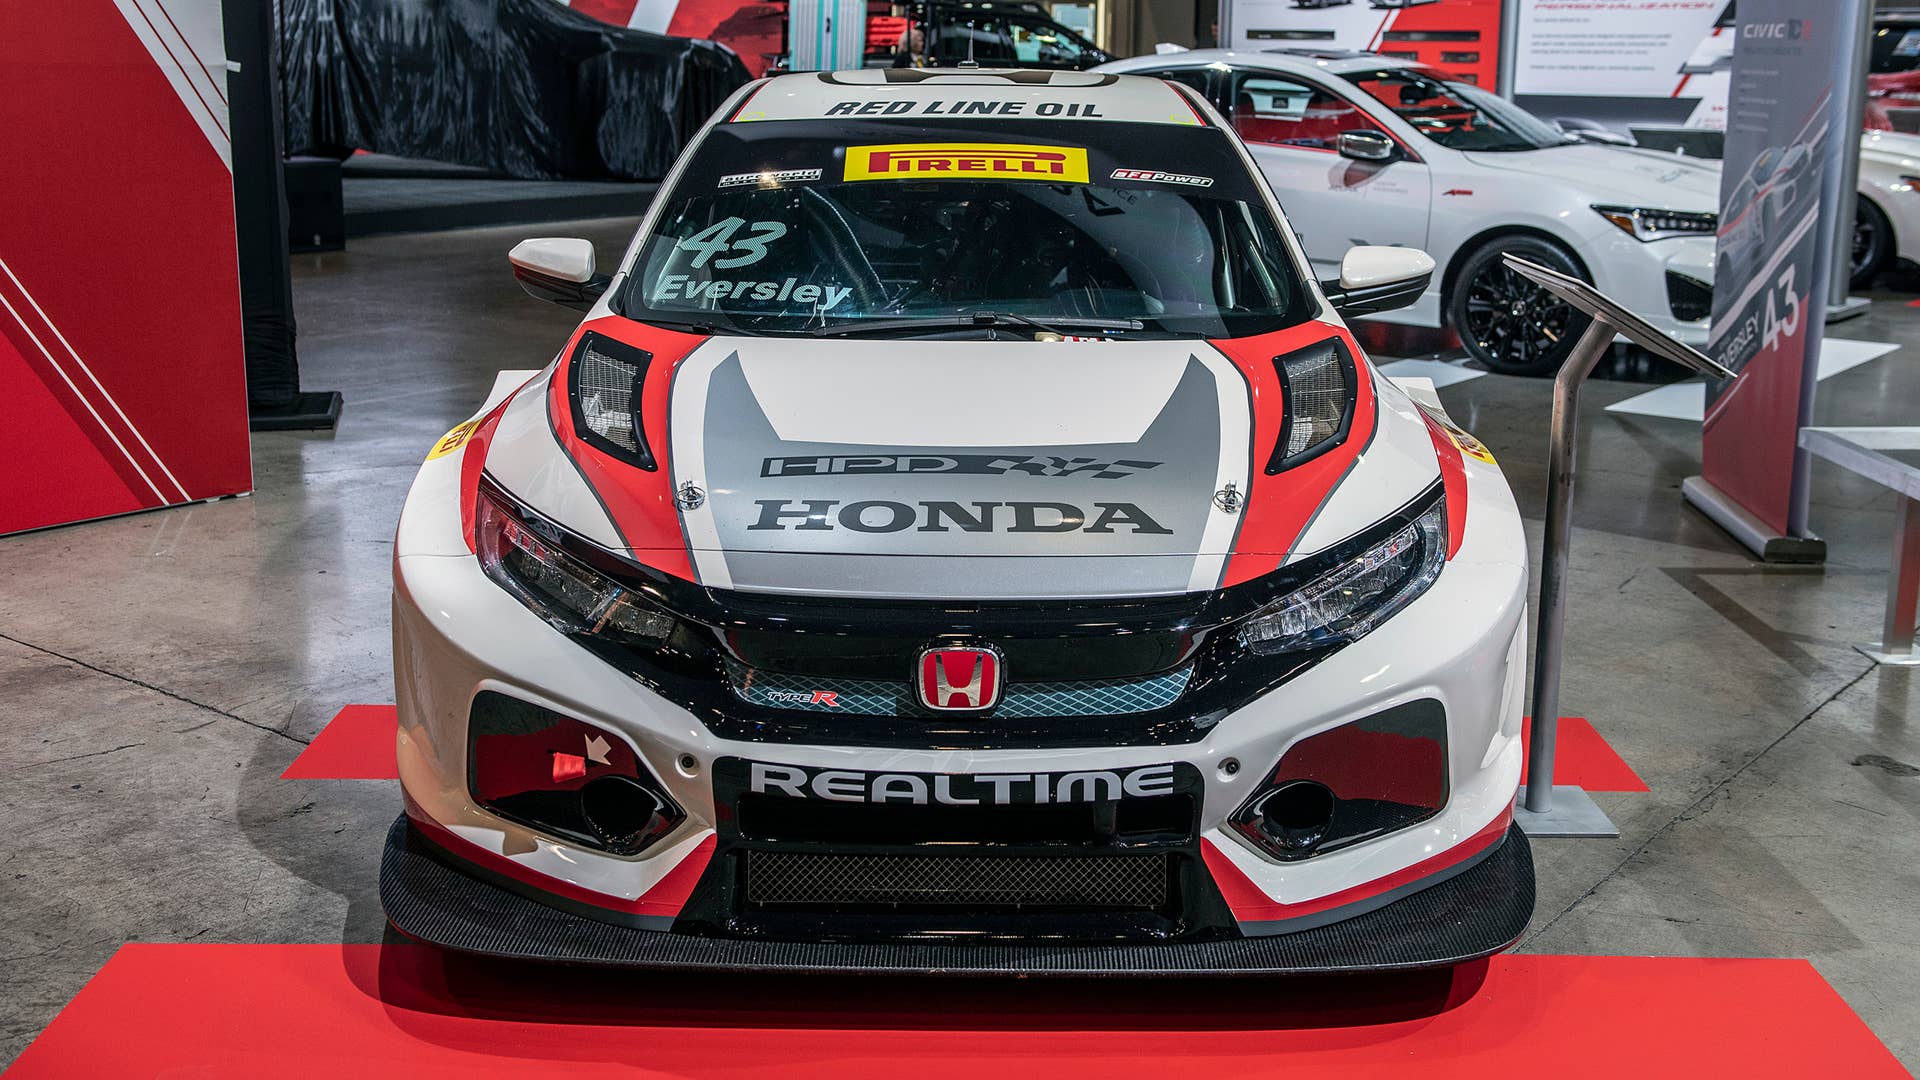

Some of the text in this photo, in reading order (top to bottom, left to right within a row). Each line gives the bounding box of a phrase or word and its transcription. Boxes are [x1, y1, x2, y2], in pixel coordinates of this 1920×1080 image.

[1743, 23, 1785, 38] CIVIC
[824, 101, 1103, 118] RED LINE OIL
[868, 149, 1067, 175] PIRELLI
[680, 216, 787, 269] 43
[654, 274, 853, 310] Eversley
[1762, 263, 1799, 352] 43
[767, 456, 960, 474] HPD
[747, 500, 1174, 535] HONDA
[751, 762, 1174, 805] REALTIME
